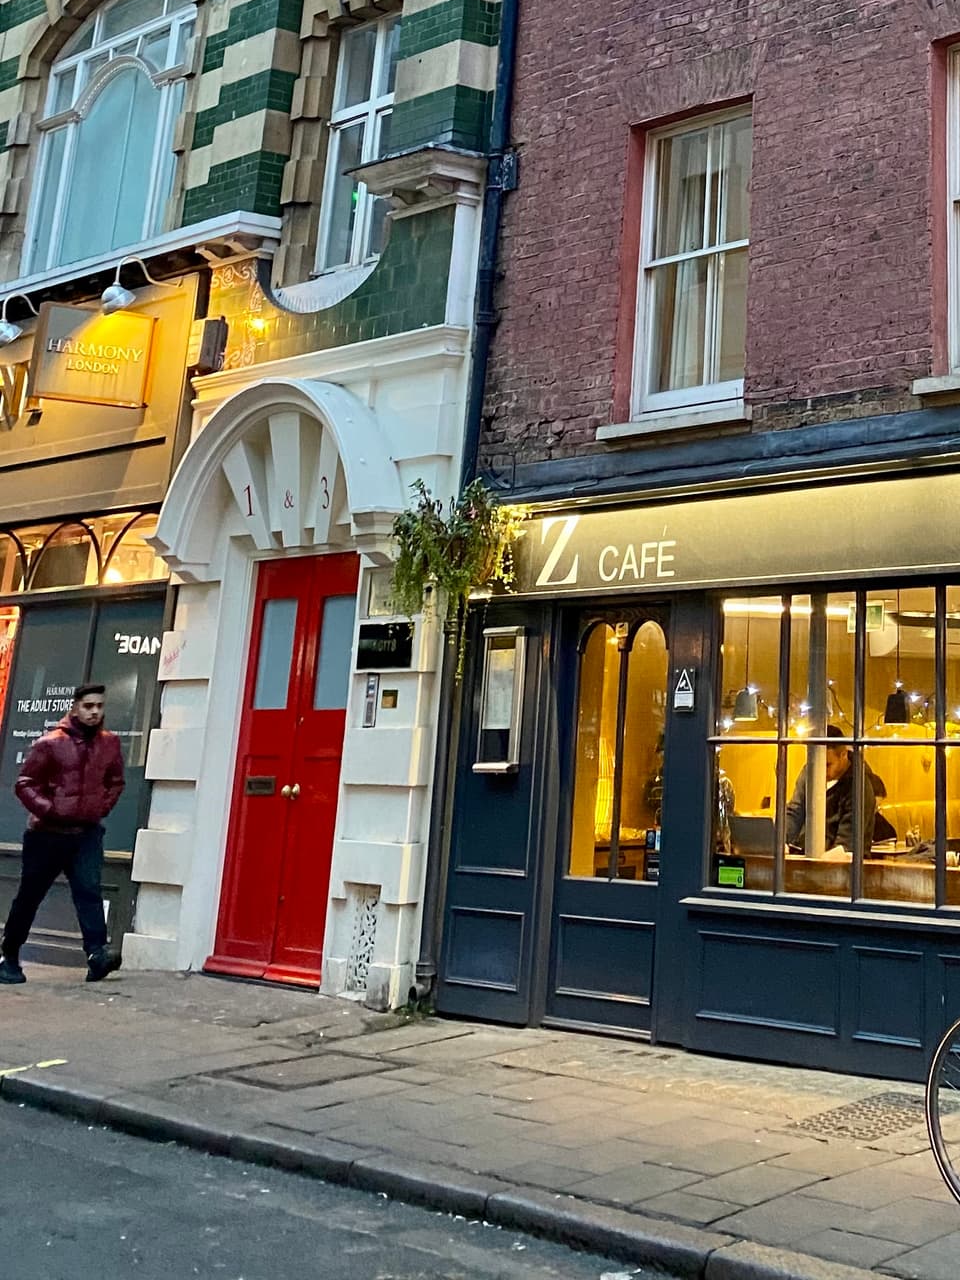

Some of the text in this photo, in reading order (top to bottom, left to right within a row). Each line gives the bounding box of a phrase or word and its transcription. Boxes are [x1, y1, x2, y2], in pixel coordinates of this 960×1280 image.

[66, 358, 120, 374] LONDON
[243, 476, 330, 517] 1 & 3
[535, 515, 677, 587] Z CAFÉ
[17, 698, 75, 713] THE ADULT STORE
